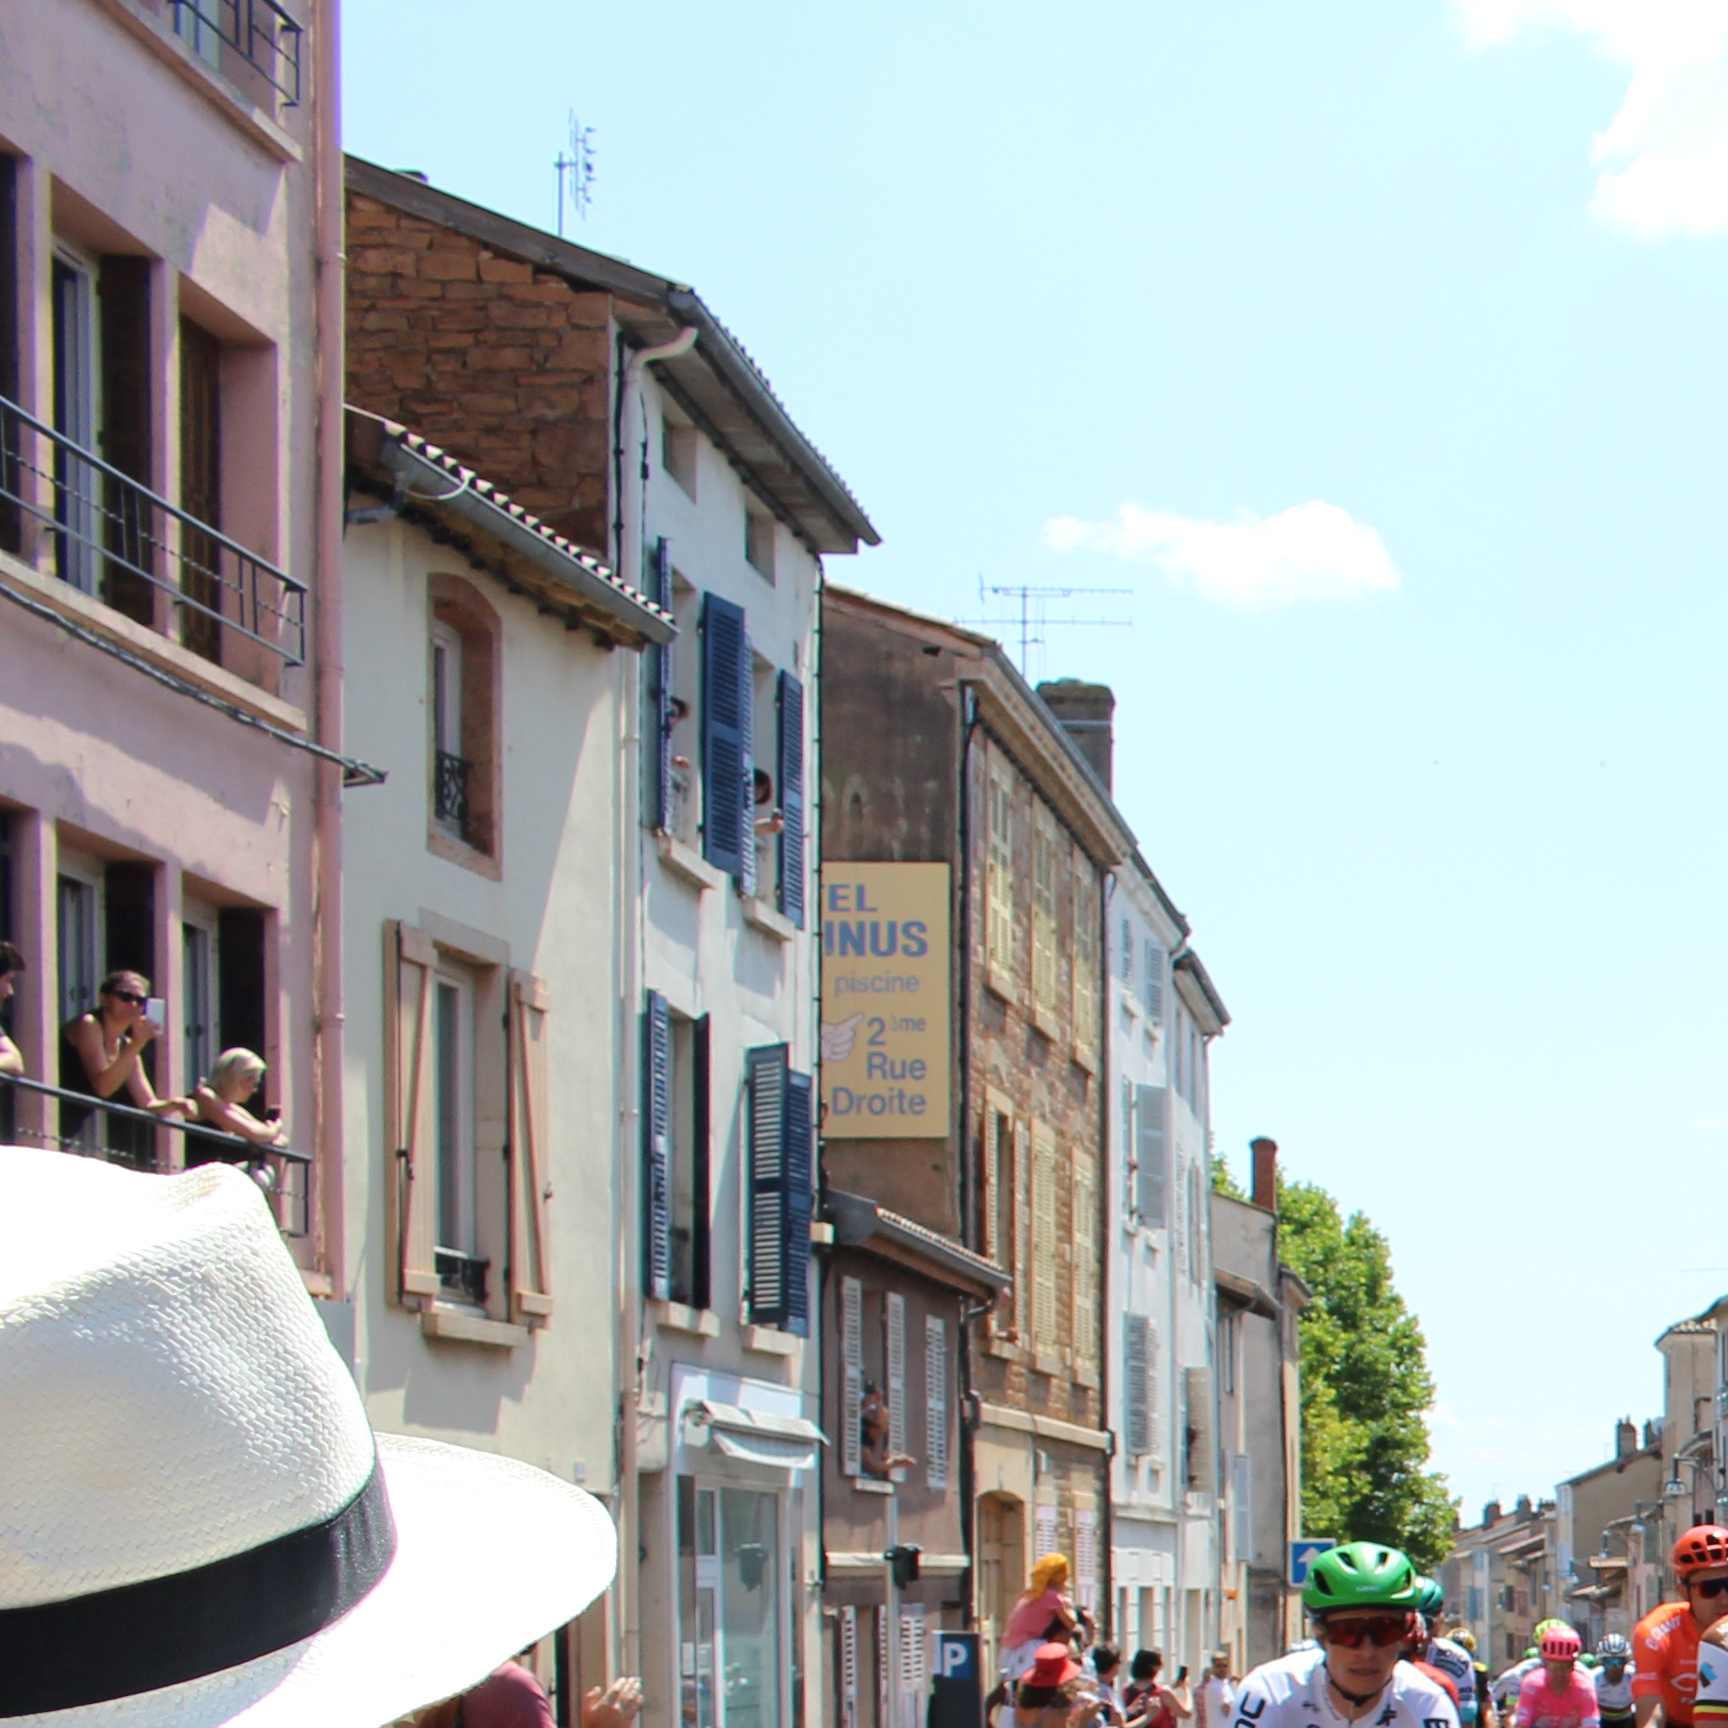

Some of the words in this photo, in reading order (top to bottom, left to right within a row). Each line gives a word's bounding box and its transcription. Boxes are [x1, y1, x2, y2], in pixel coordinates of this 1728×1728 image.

[822, 884, 877, 912] EL
[834, 970, 919, 997] piscine
[867, 1052, 926, 1080] Rue
[832, 1086, 926, 1116] Droite
[943, 1642, 968, 1677] P
